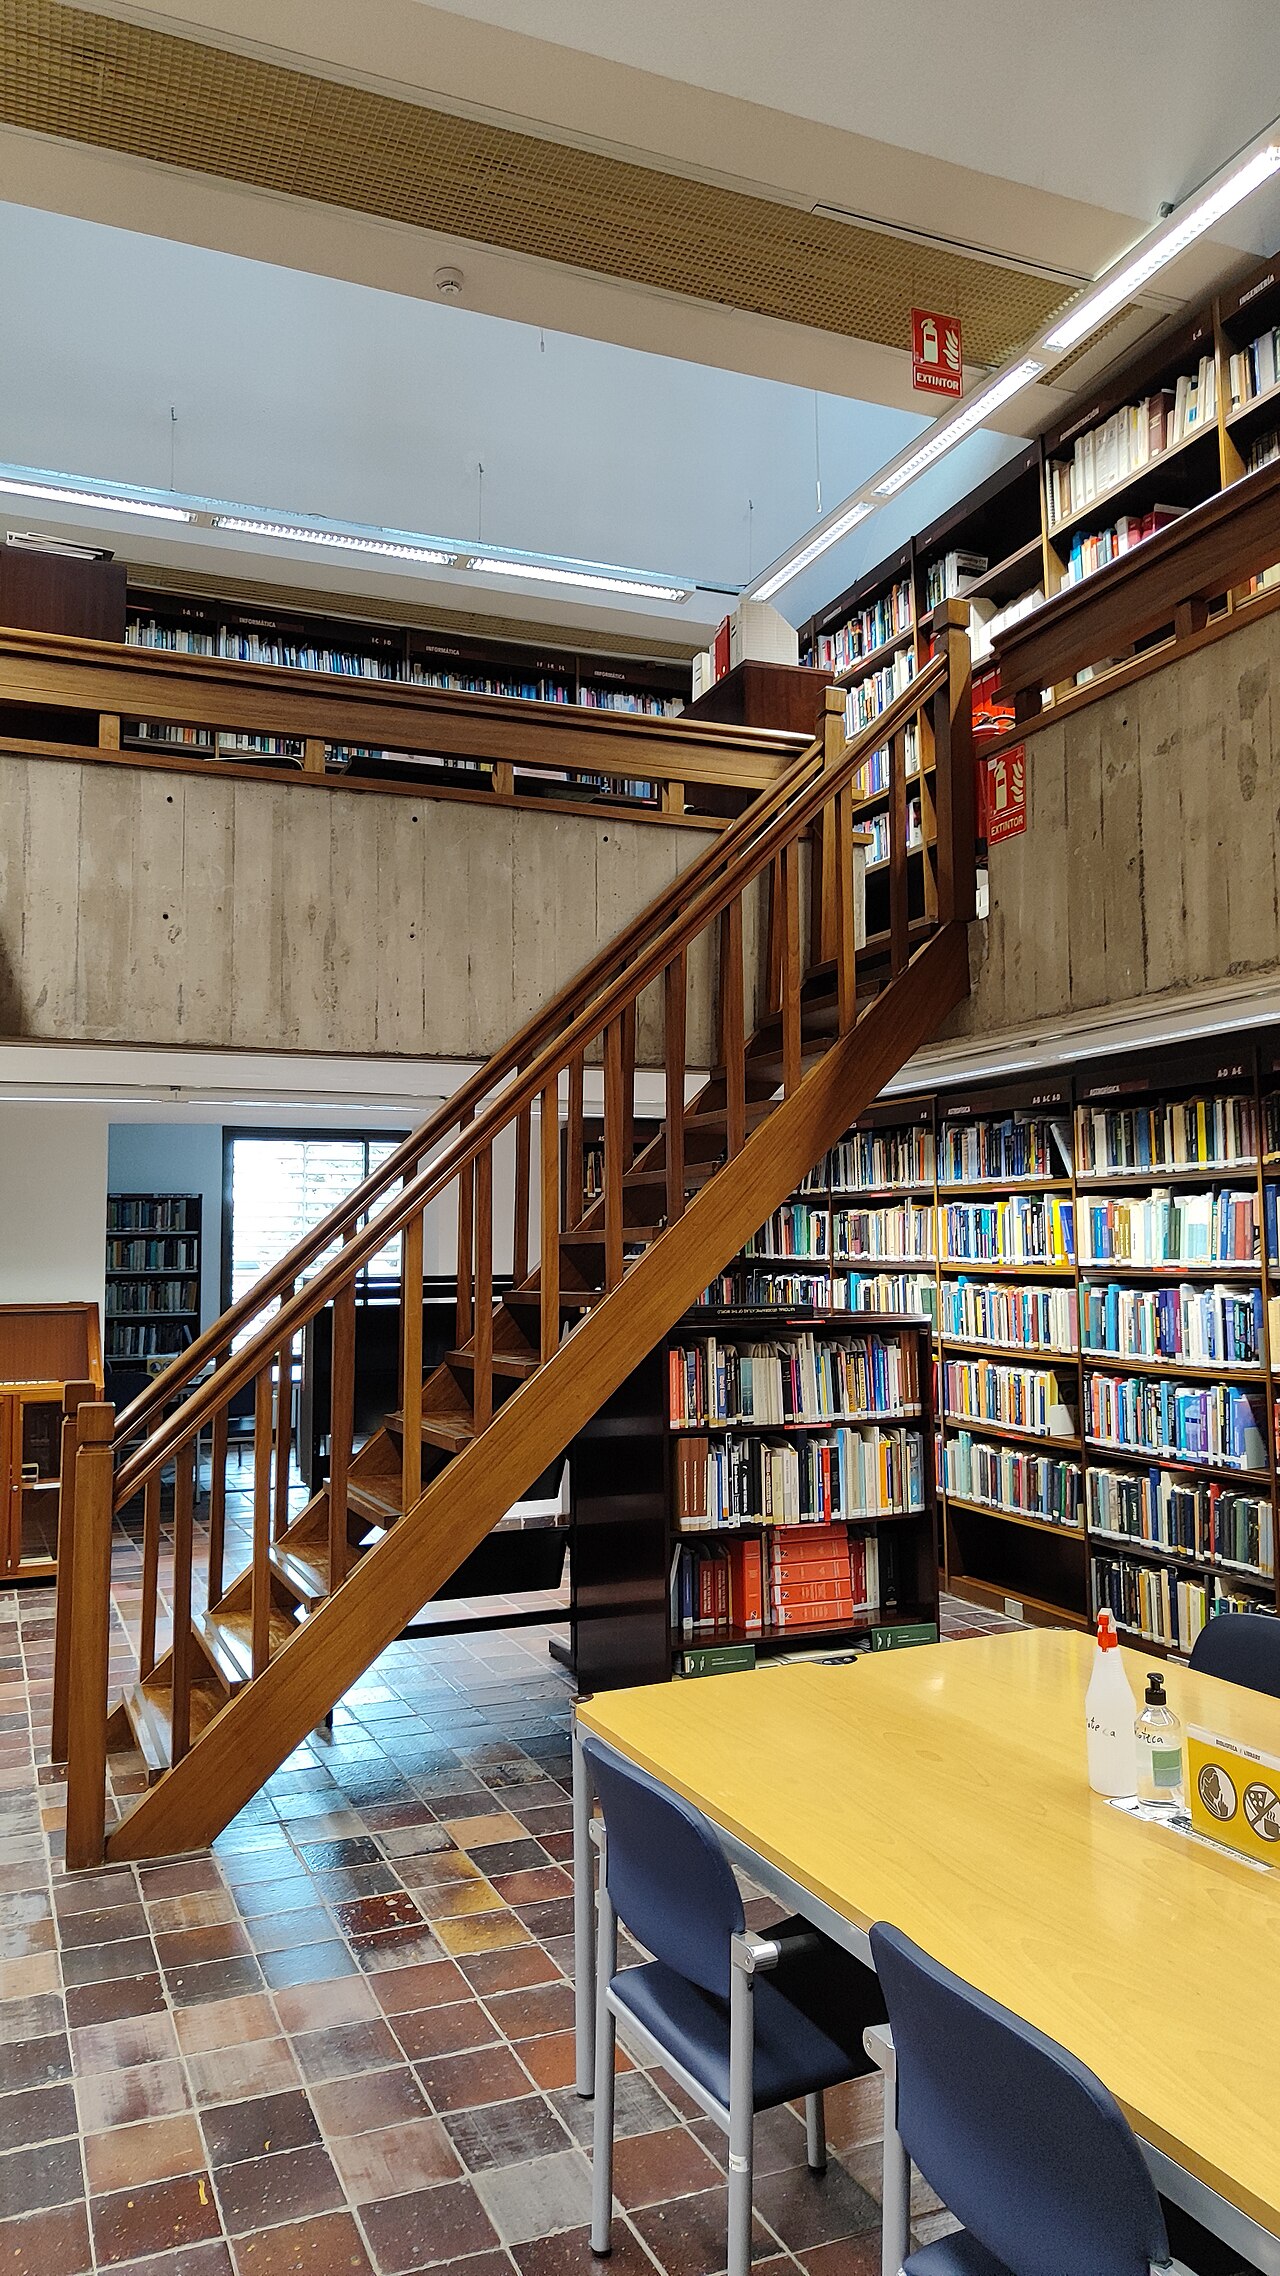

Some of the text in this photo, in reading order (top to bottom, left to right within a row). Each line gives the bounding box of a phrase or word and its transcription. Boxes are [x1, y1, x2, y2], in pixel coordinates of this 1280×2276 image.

[916, 372, 959, 391] EXTINTOR
[239, 617, 276, 628] INFORMÁTICA
[425, 645, 460, 656] INFORMÁTICA
[594, 670, 625, 680] INFORMÁTICA
[991, 814, 1024, 836] EXTINTOR
